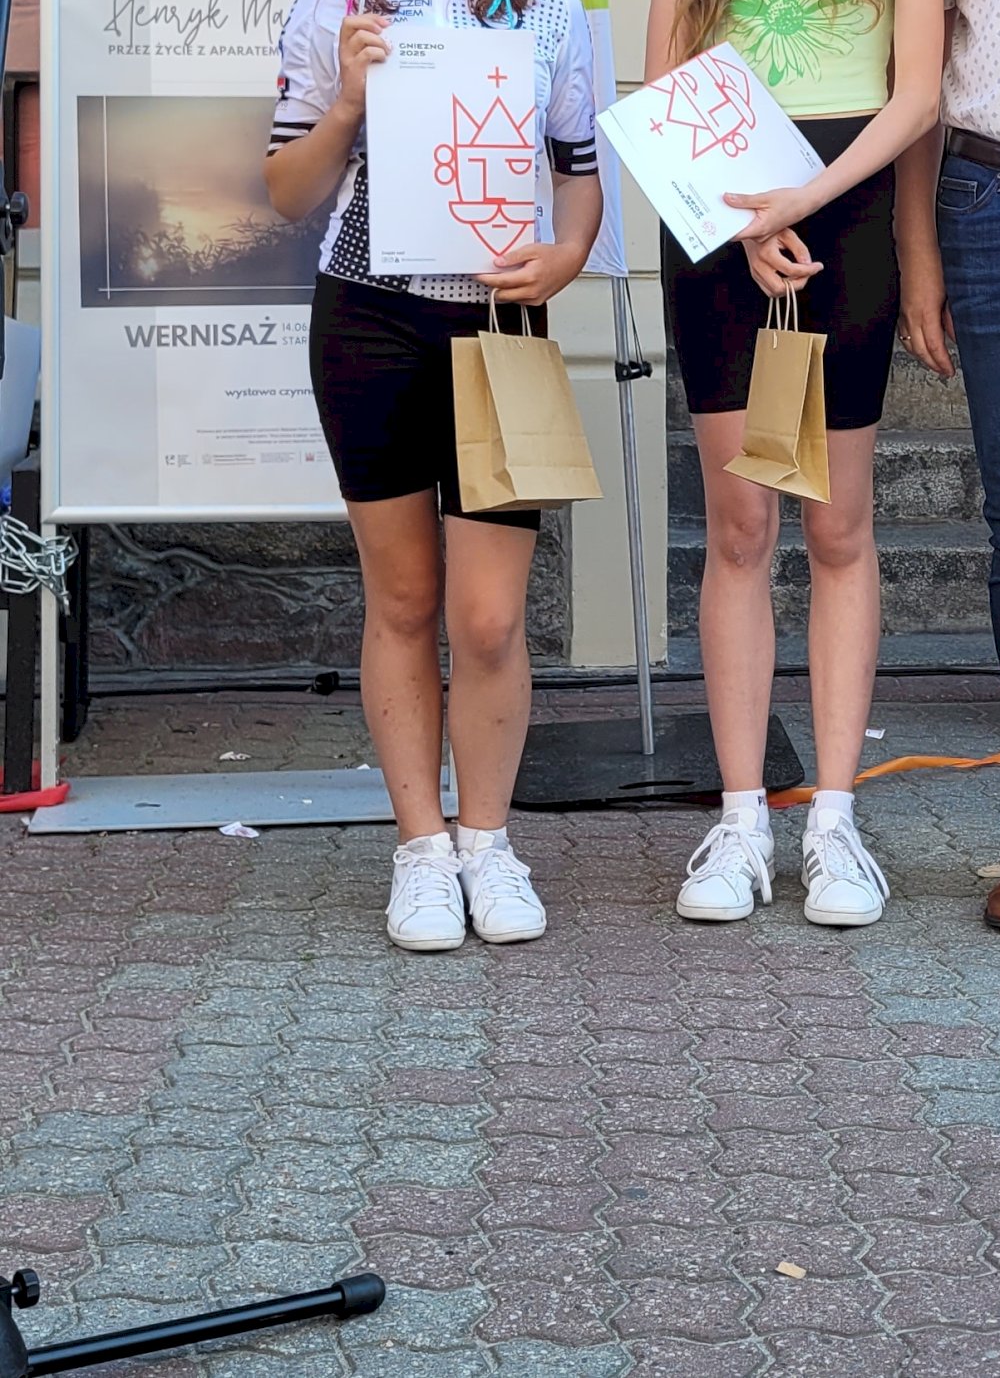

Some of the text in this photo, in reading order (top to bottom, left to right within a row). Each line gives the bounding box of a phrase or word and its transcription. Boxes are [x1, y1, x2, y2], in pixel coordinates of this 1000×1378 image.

[108, 42, 280, 57] PRZEZ ŻYCIE Z APARATEM
[124, 316, 277, 348] WERNISAŻ
[282, 336, 308, 346] STAR
[225, 388, 276, 400] wystawa
